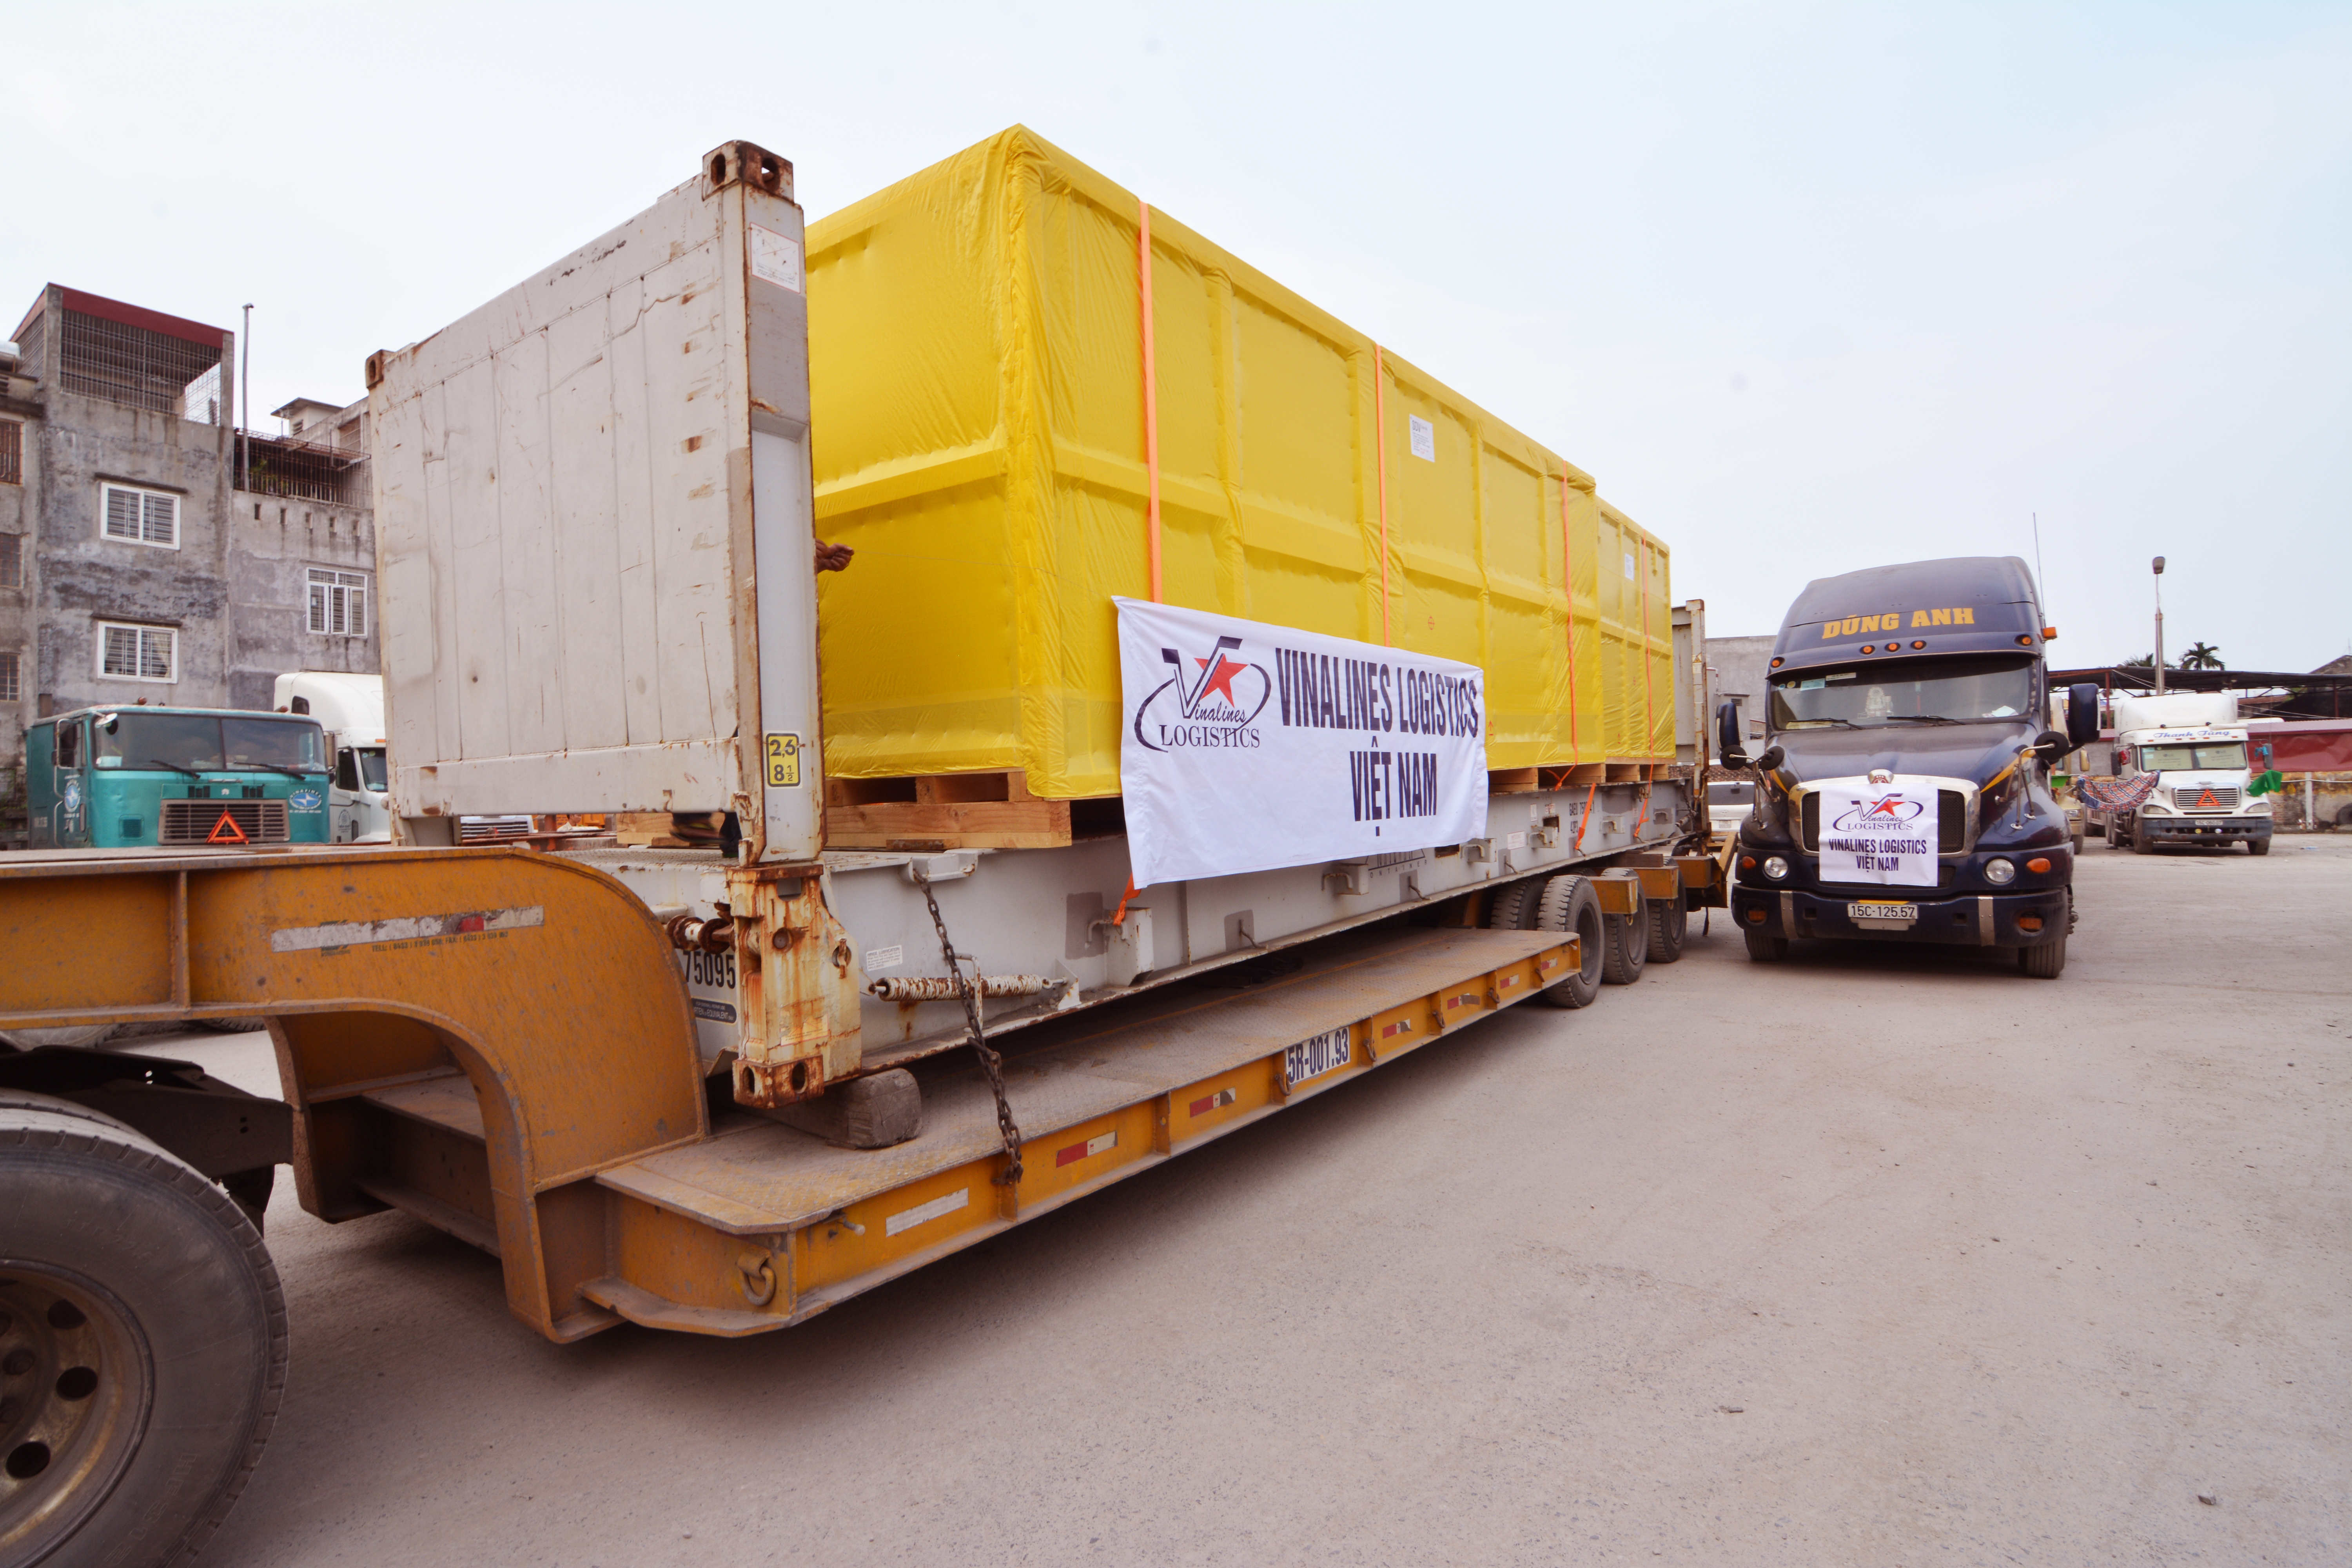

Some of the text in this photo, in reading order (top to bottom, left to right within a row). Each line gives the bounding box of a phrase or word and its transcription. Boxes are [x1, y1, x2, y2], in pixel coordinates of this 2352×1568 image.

[1822, 608, 1975, 639] DŨNG ANH
[1275, 647, 1479, 738] VINALINES LOGISTICS
[1159, 724, 1260, 748] LOGISTICS
[769, 739, 796, 758] 2,6
[1350, 735, 1437, 837] VIỆT NAM
[1829, 838, 1927, 855] VINALINES LOGISTICS
[1370, 859, 1427, 878] ONTAINER
[1856, 853, 1899, 873] VIỆT NAM
[1851, 905, 1915, 918] 15C-125.57
[1288, 1028, 1348, 1083] 5R-001.93
